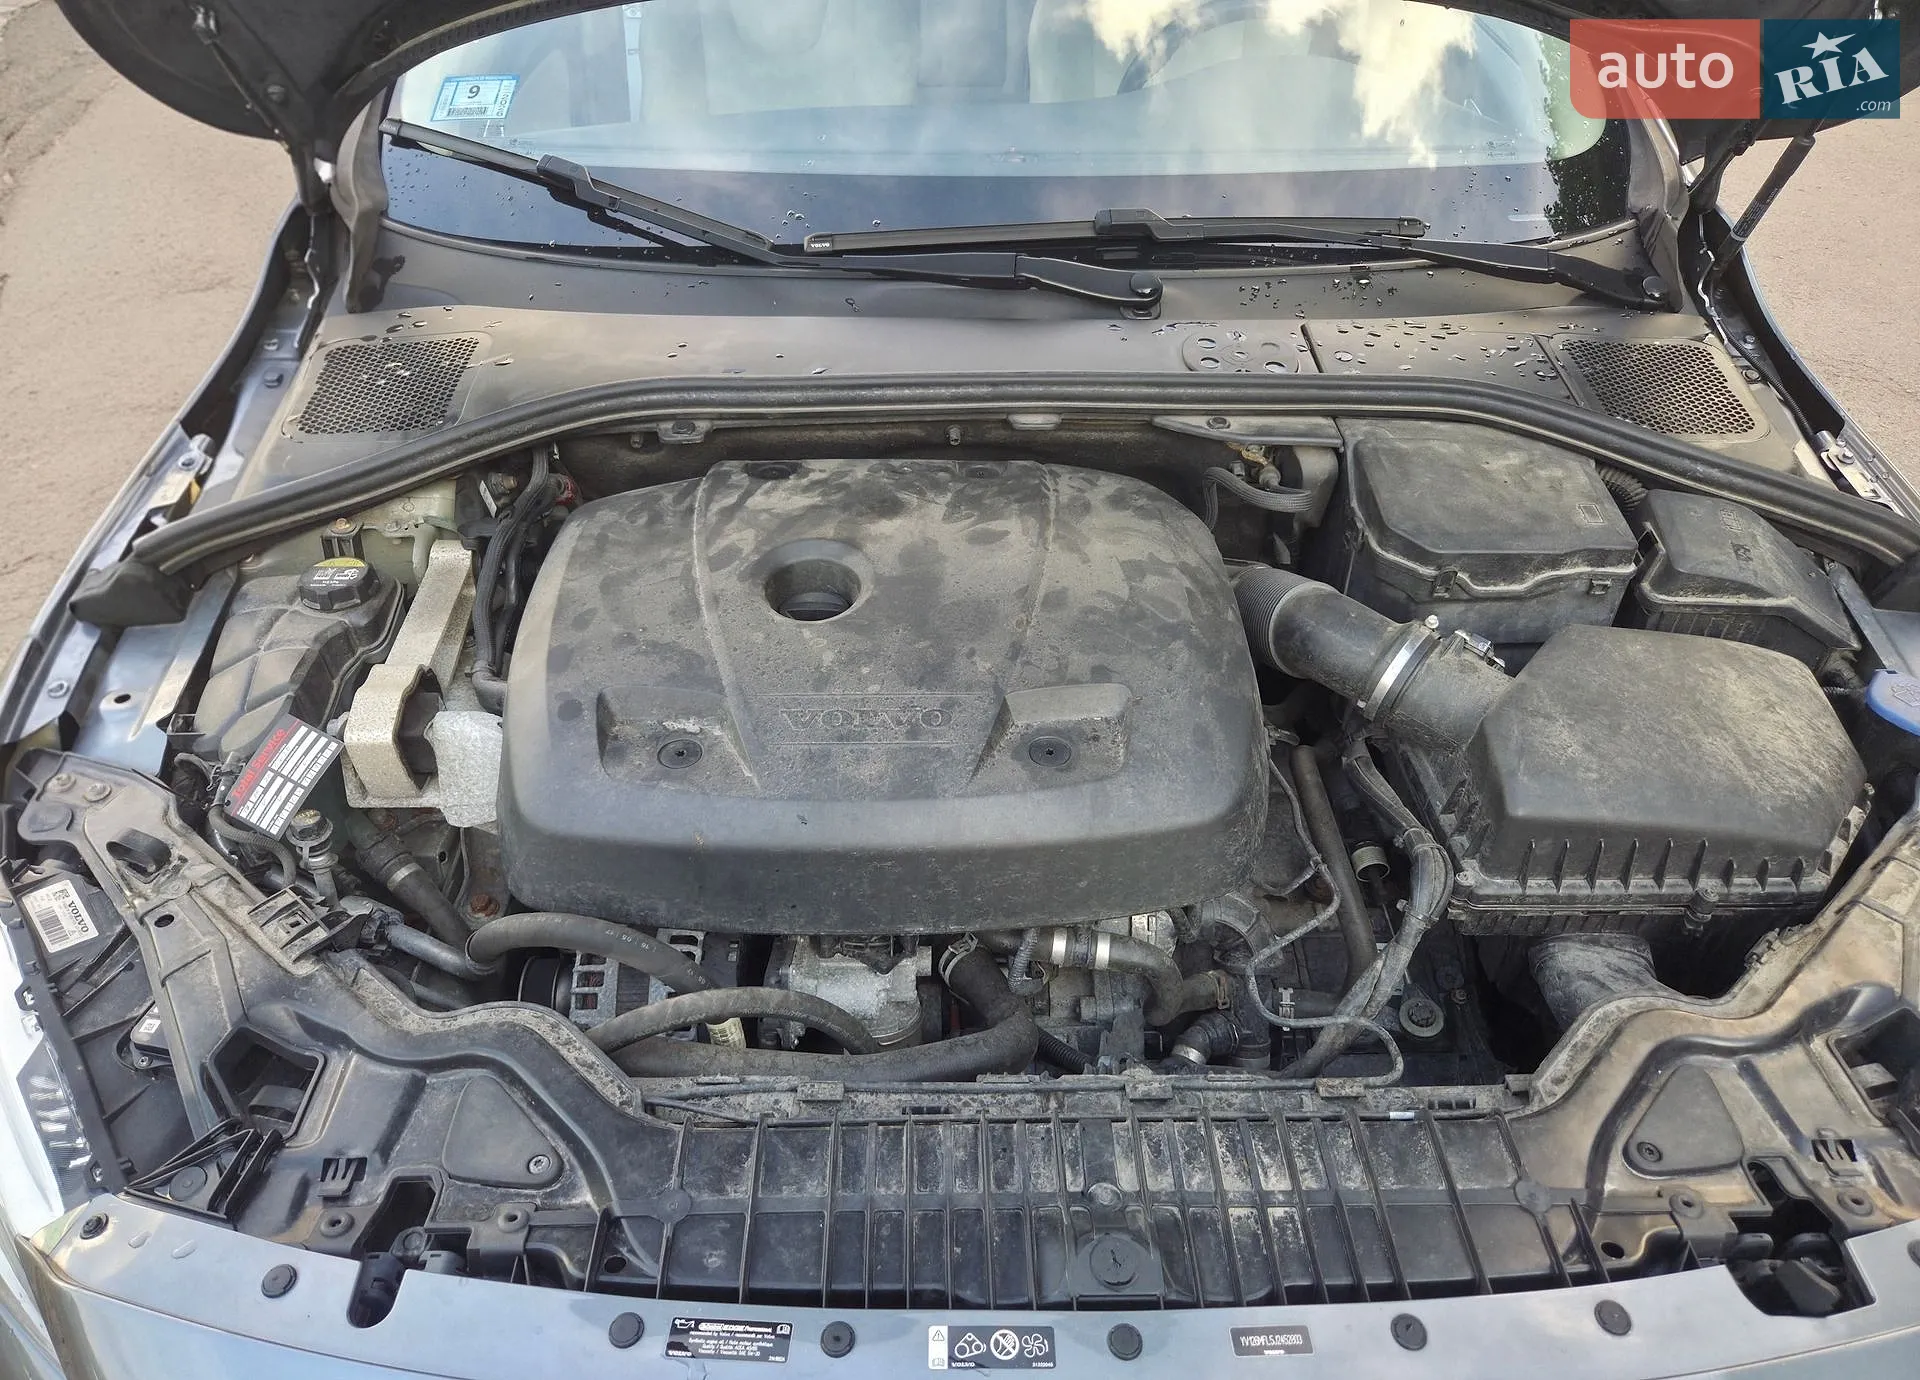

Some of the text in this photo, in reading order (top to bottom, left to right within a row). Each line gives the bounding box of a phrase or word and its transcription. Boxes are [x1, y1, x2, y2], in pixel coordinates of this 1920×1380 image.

[467, 85, 481, 99] 9
[779, 708, 954, 731] VOLVO
[231, 728, 288, 798] Total Service
[68, 900, 90, 933] VOLVO
